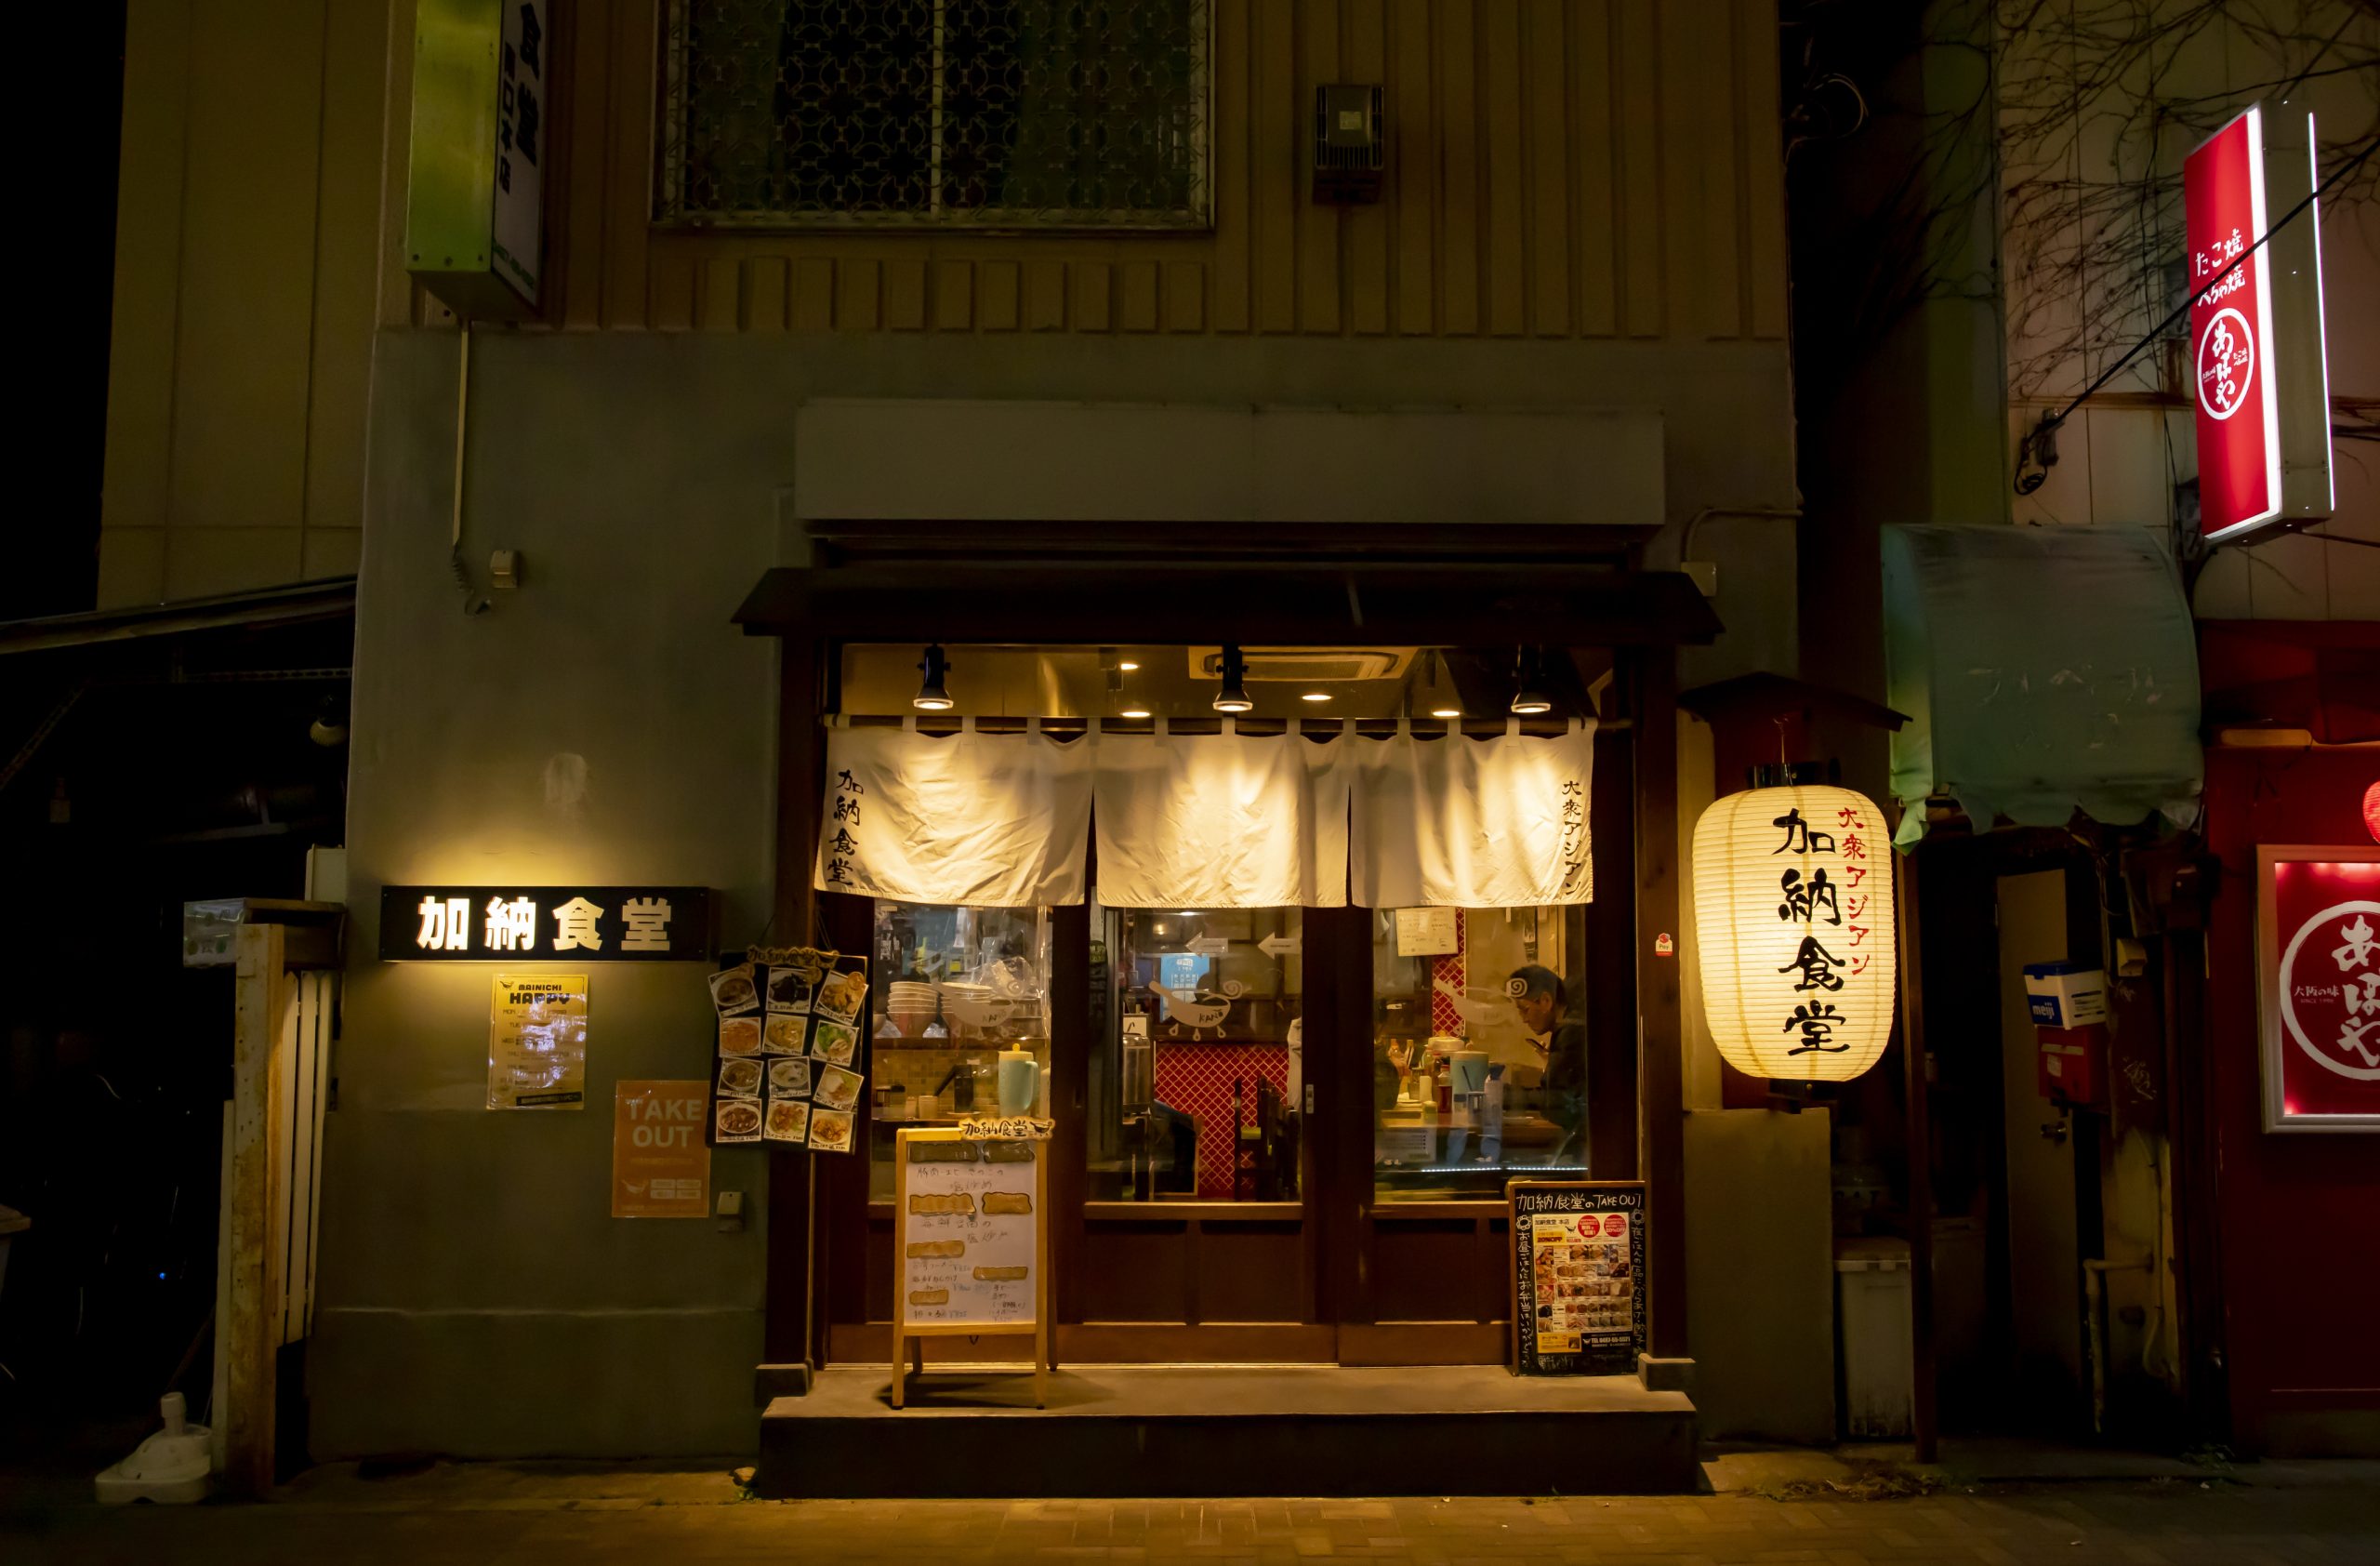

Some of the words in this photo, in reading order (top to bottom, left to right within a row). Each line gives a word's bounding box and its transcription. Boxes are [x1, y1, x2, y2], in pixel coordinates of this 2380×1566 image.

[2195, 228, 2244, 277] たこ焼
[2211, 318, 2236, 410] あほや
[827, 769, 865, 886] 加納食堂
[1561, 780, 1583, 896] 大衆アジアン
[1837, 807, 1871, 975] 大衆アジアン
[416, 896, 671, 952] 加納食堂
[1772, 808, 1851, 1056] 加納食堂
[509, 992, 571, 1004] HAPPY
[2031, 1002, 2056, 1019] meiji
[2294, 984, 2340, 997] 大阪の味
[625, 1099, 702, 1121] TAKE
[963, 1121, 1027, 1136] 加納食堂
[632, 1125, 694, 1148] OUT
